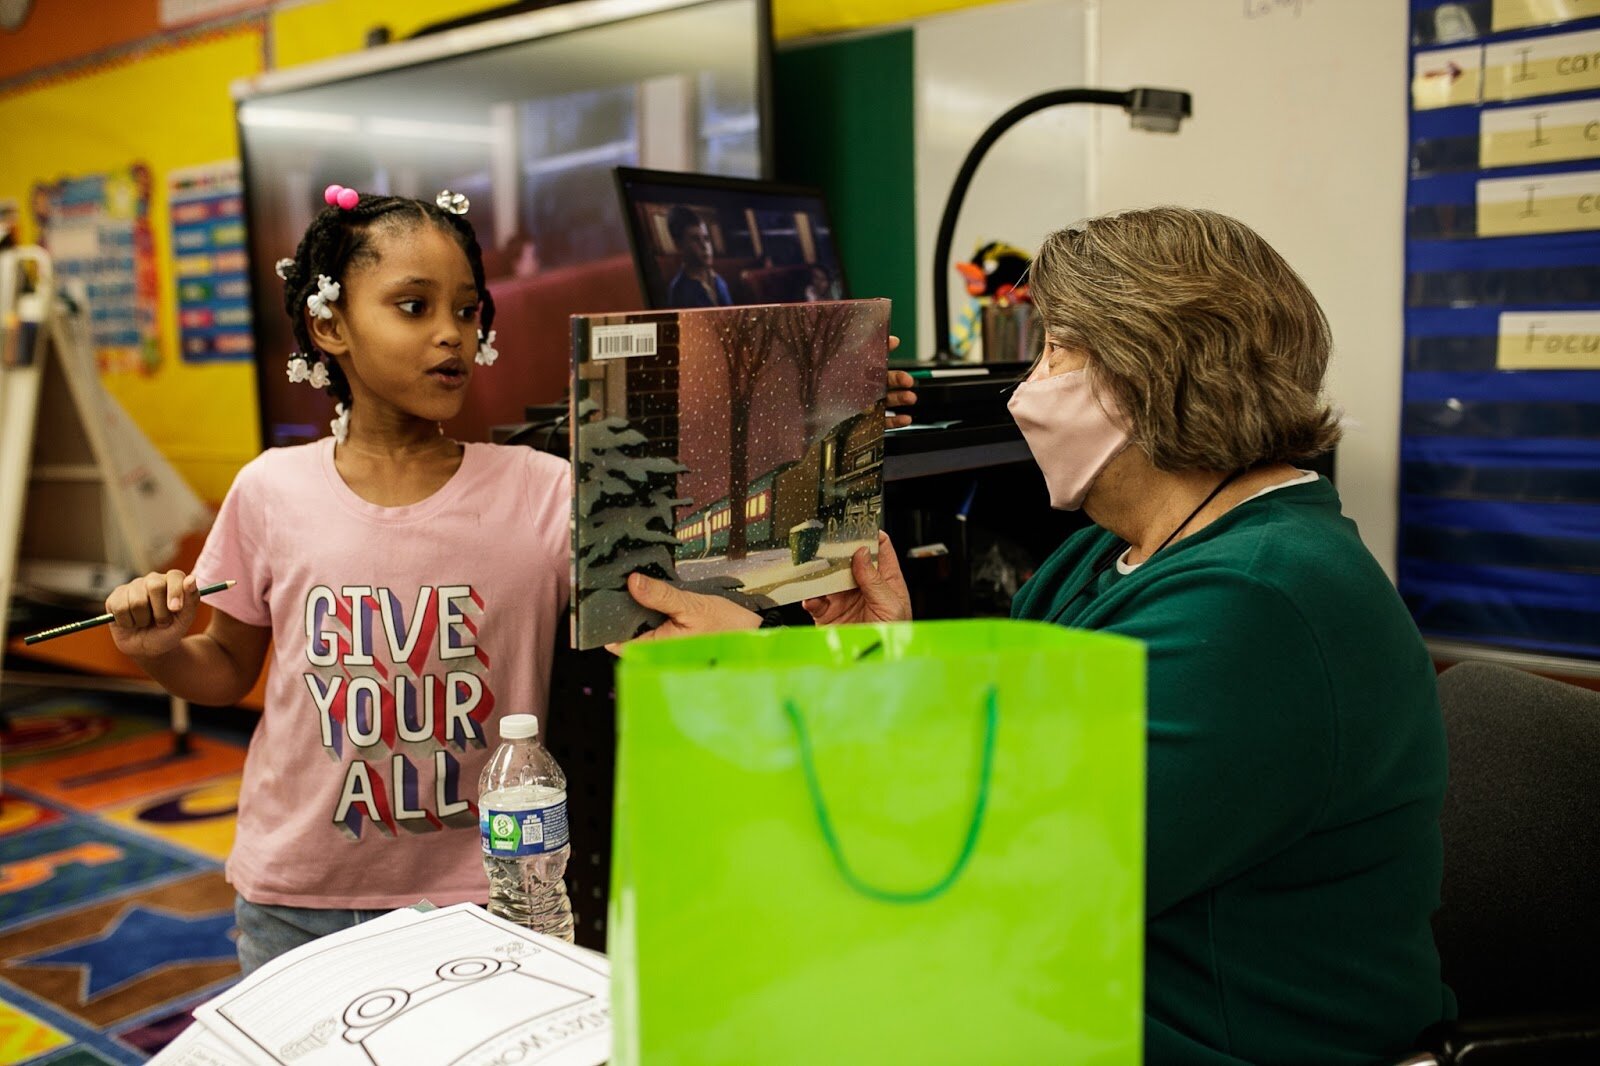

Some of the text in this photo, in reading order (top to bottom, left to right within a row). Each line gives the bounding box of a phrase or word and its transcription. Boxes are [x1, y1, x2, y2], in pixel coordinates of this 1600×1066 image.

[1512, 45, 1537, 83] I
[1527, 111, 1551, 148] I
[1518, 182, 1545, 218] I
[304, 585, 476, 666] GIVE
[303, 670, 483, 748] YOUR
[332, 750, 469, 823] ALL
